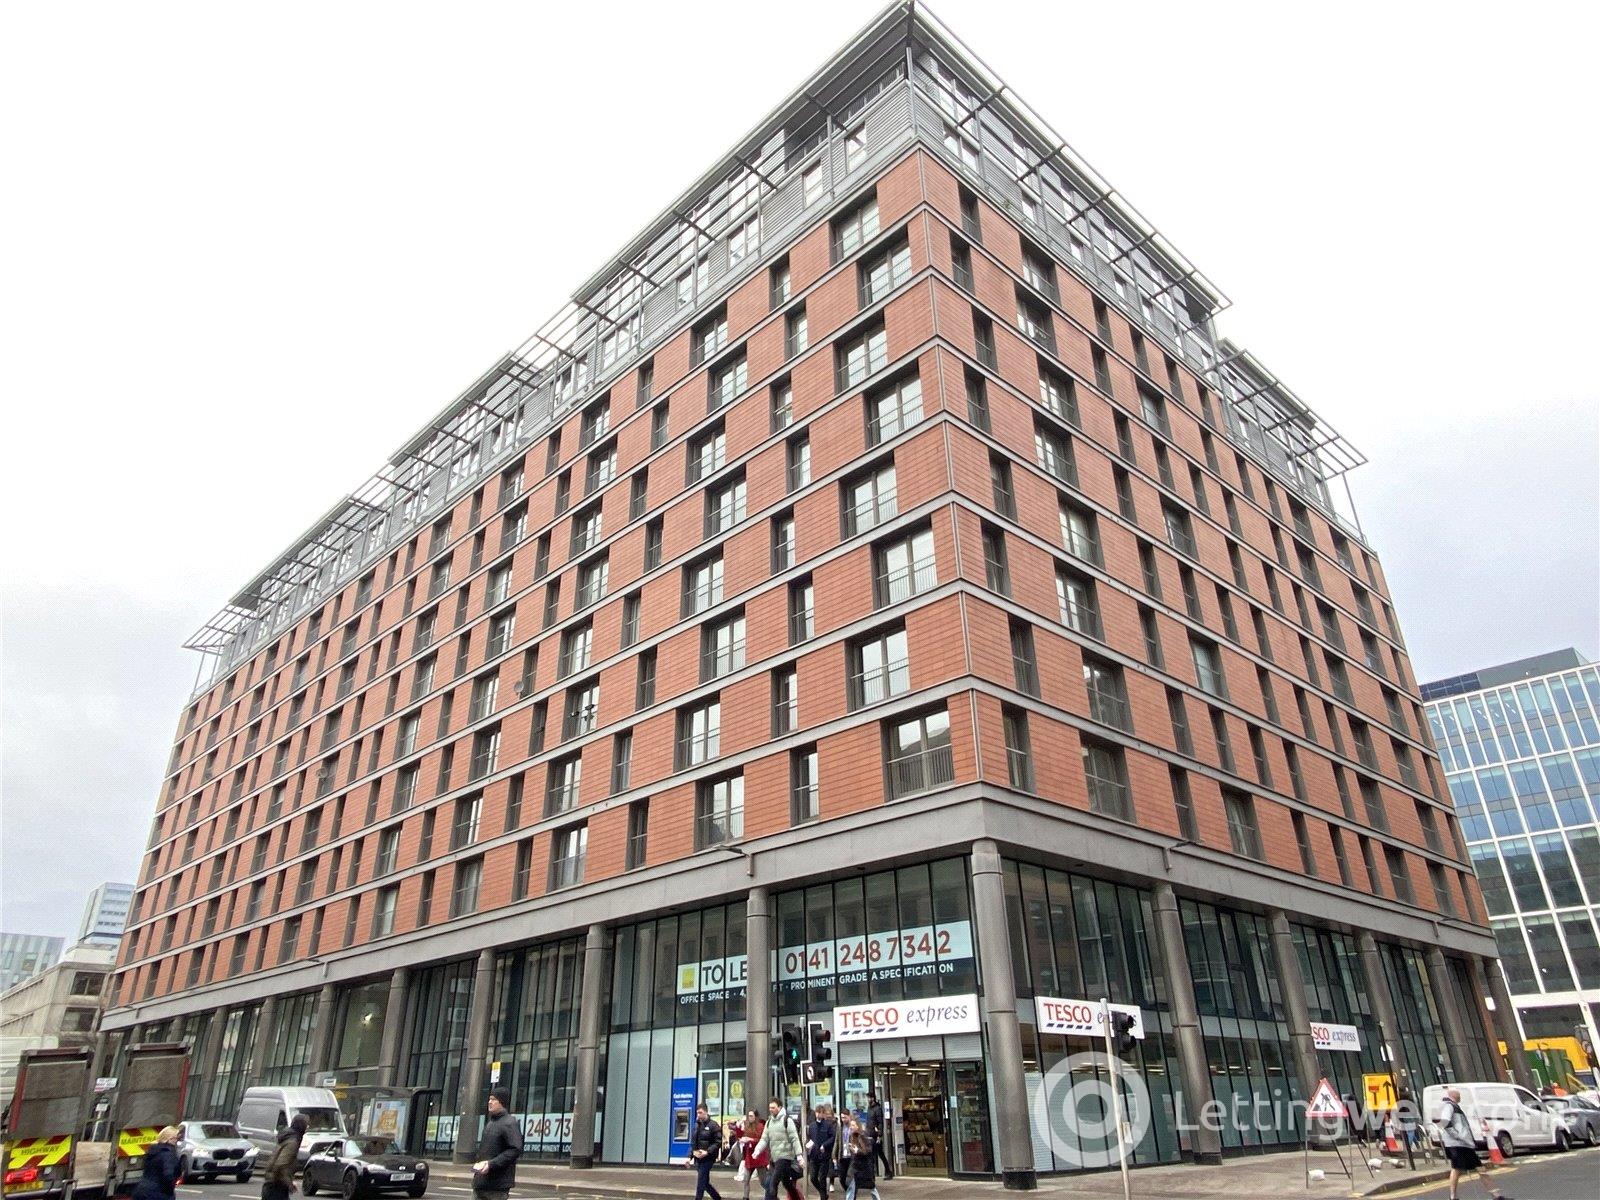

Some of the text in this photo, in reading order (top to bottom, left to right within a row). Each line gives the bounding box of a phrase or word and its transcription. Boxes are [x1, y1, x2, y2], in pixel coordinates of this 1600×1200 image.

[785, 930, 952, 974] 0141 248 7342
[702, 961, 747, 986] TO LE
[790, 976, 836, 991] PROMINENT
[839, 972, 868, 984] GRADE
[871, 971, 878, 980] A
[879, 963, 954, 979] SPECIFICATION
[680, 993, 704, 1005] OFFICE
[707, 991, 730, 1001] SPACE
[839, 1004, 968, 1029] TESCO express
[1043, 1002, 1092, 1023] TESCO
[1312, 1027, 1356, 1045] SCO express
[527, 1119, 551, 1138] 248
[554, 1118, 573, 1138] 73
[20, 1145, 60, 1155] HIGHWAY
[121, 1135, 157, 1146] MAINTENA
